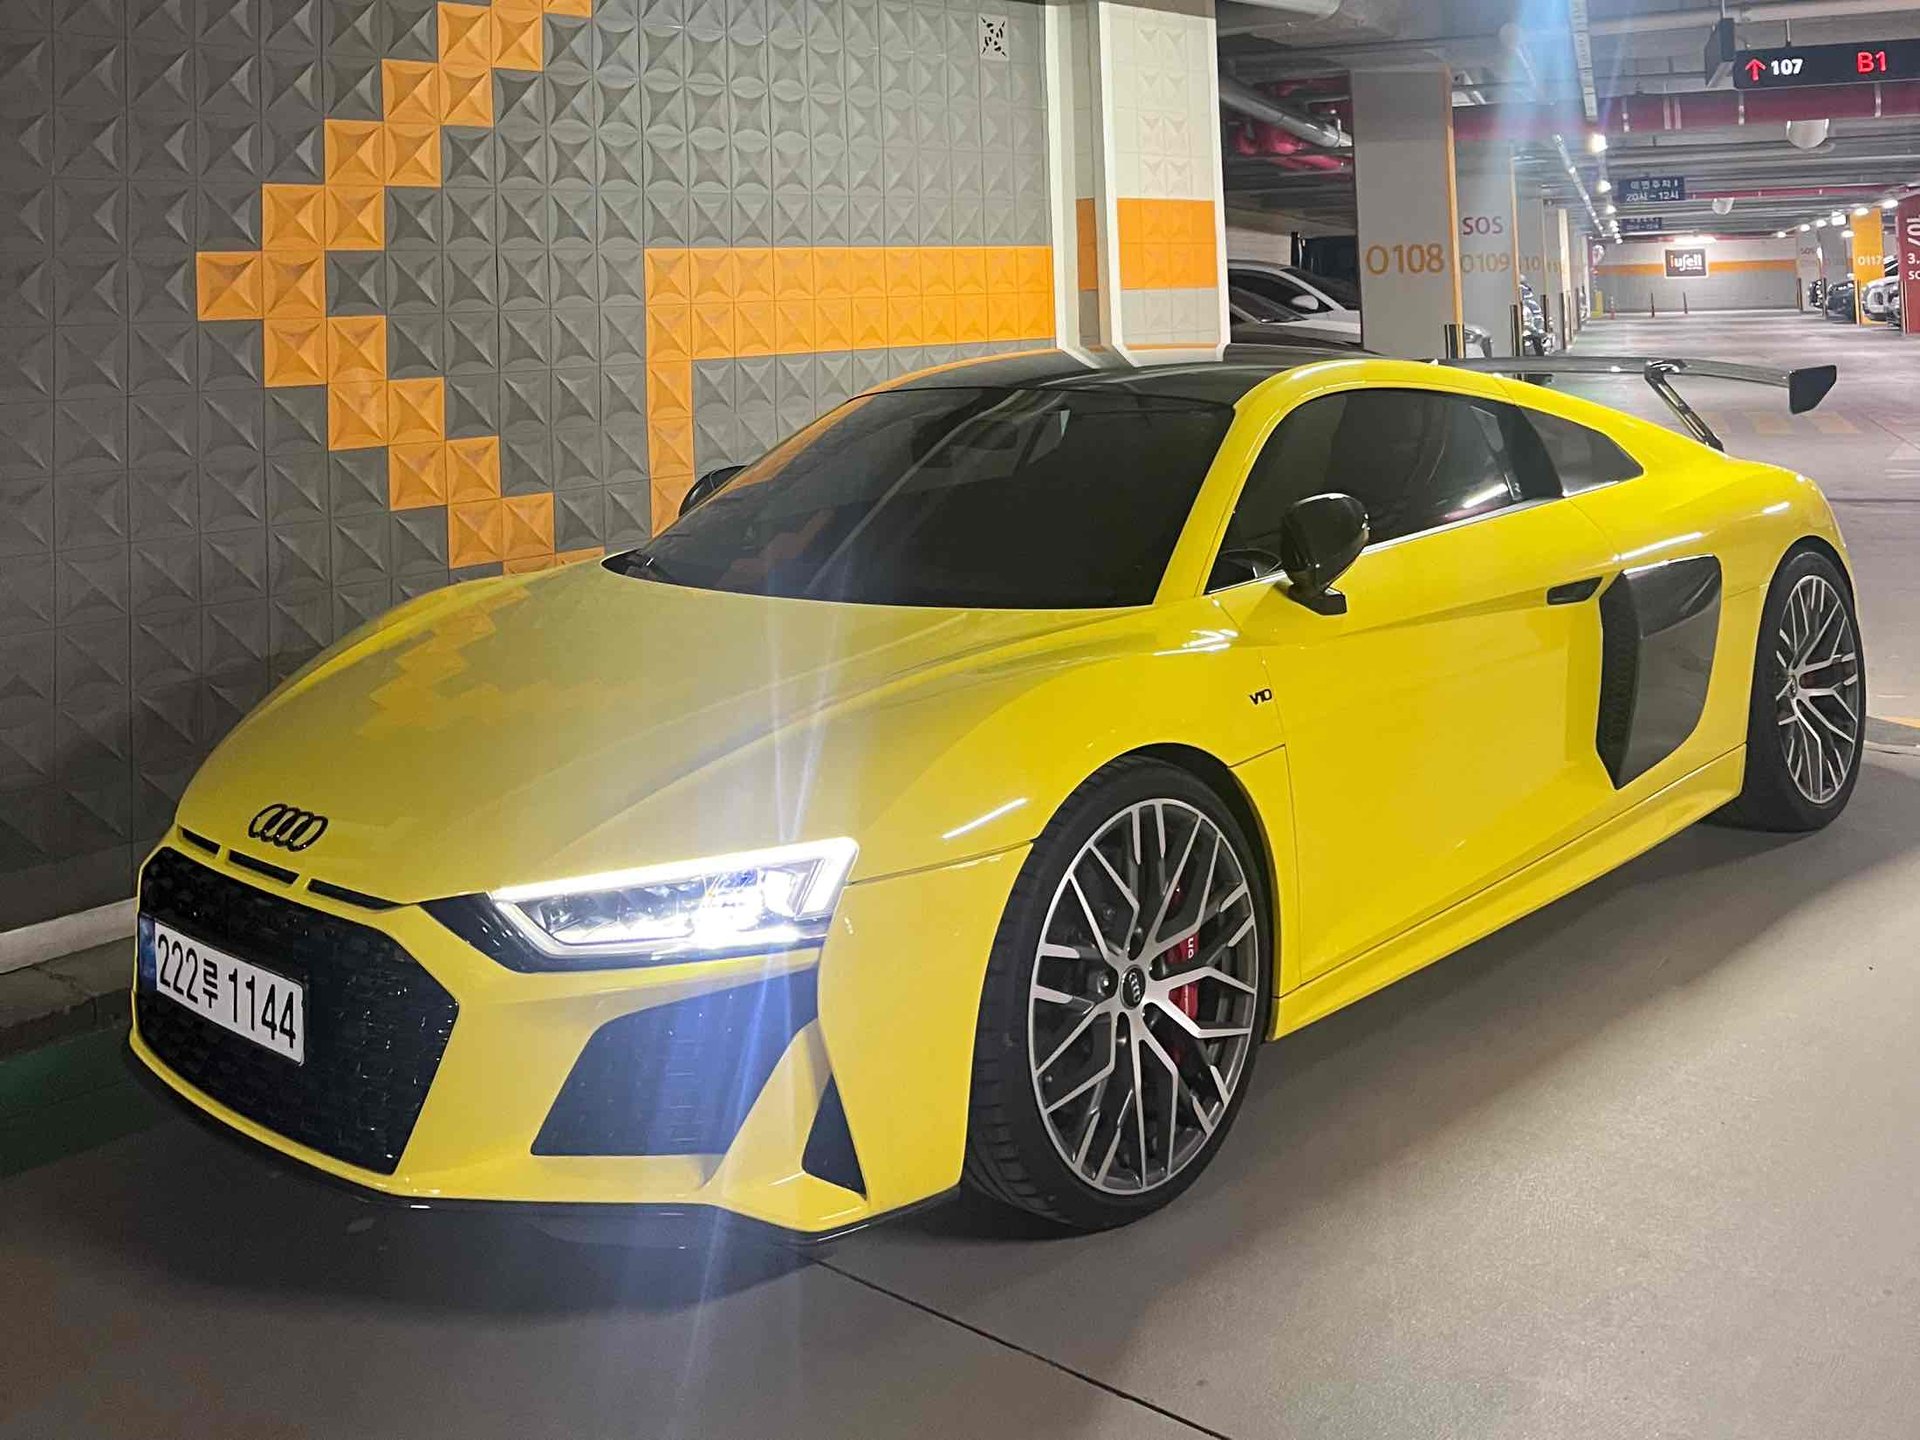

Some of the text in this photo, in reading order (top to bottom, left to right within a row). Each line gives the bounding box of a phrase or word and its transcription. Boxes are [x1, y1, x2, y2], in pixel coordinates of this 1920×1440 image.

[1770, 51, 1887, 76] 107 B1
[1462, 216, 1504, 236] SOS
[1249, 688, 1272, 705] V10
[158, 934, 296, 1049] 222루 1144
